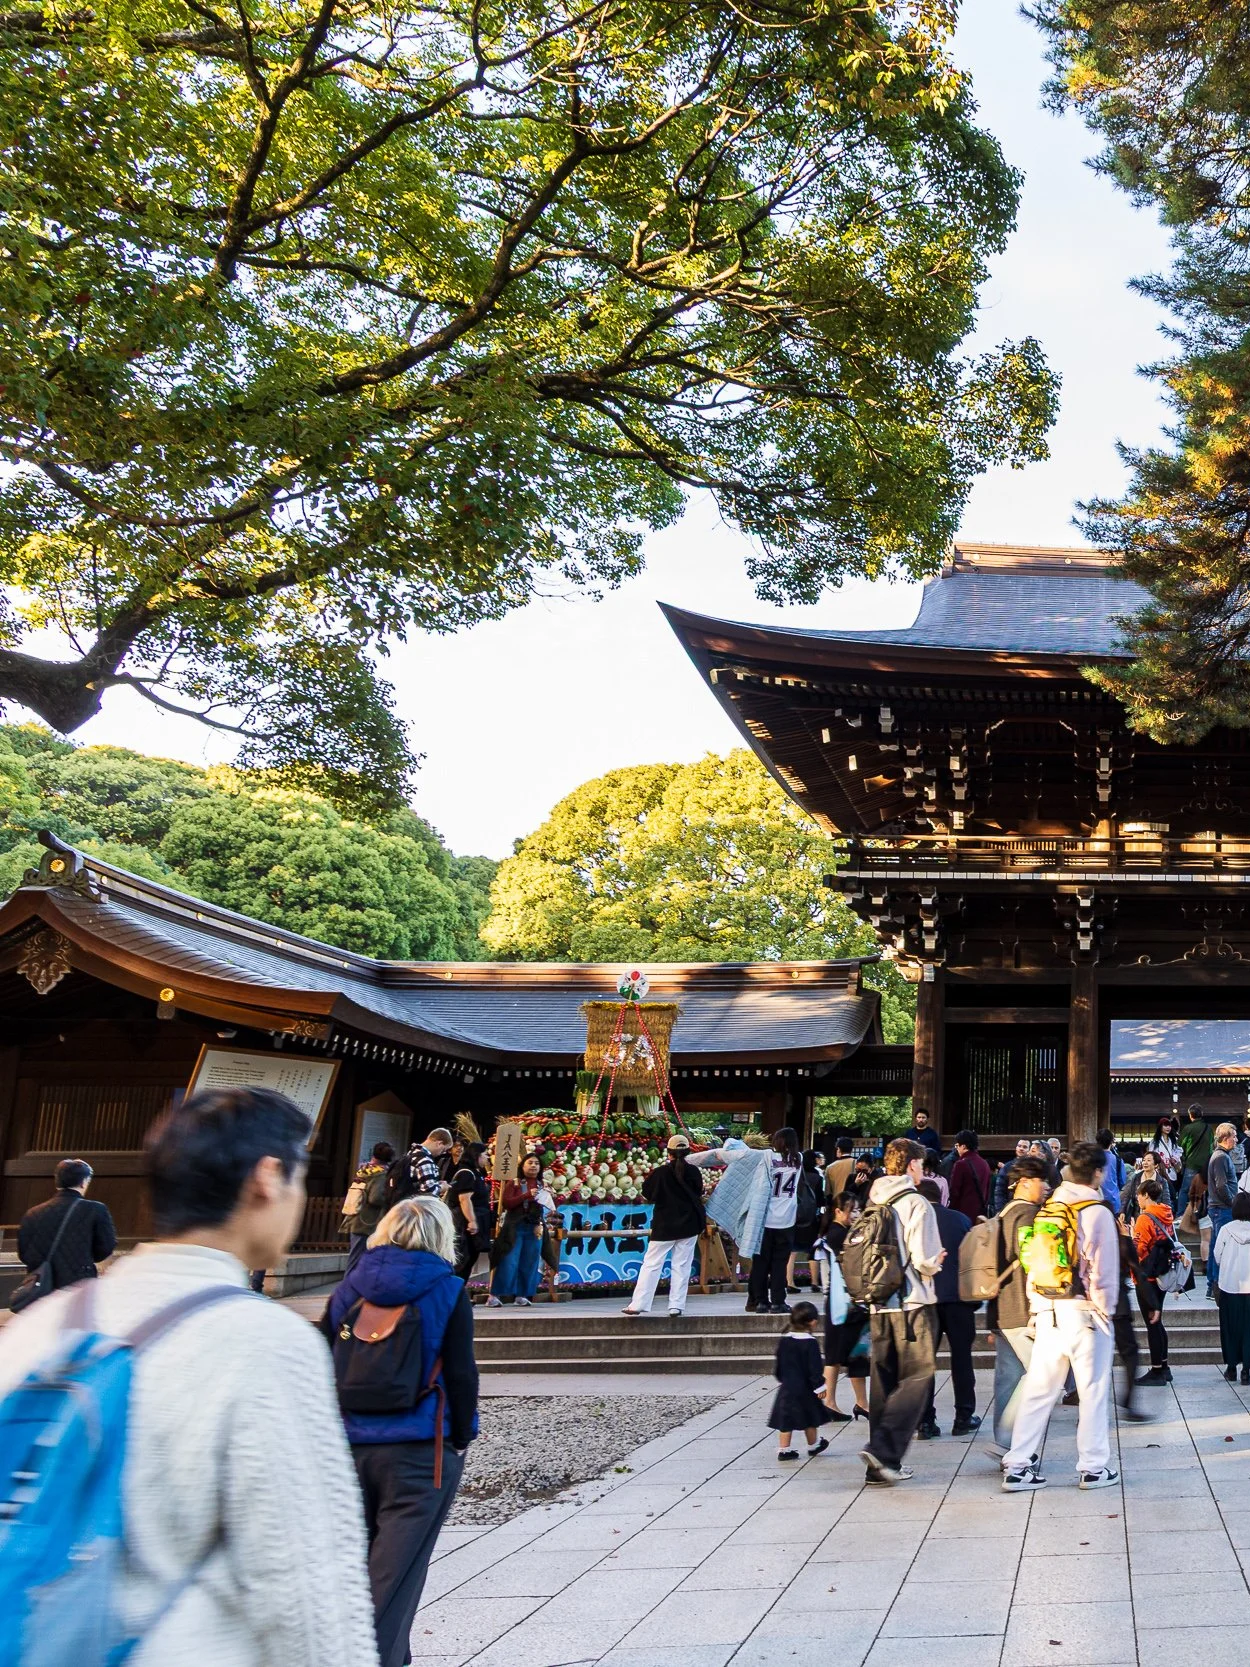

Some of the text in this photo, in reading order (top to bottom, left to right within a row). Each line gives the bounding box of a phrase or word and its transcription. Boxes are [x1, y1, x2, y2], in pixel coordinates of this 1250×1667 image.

[501, 1133, 513, 1175] JA八王子
[773, 1171, 797, 1199] 14
